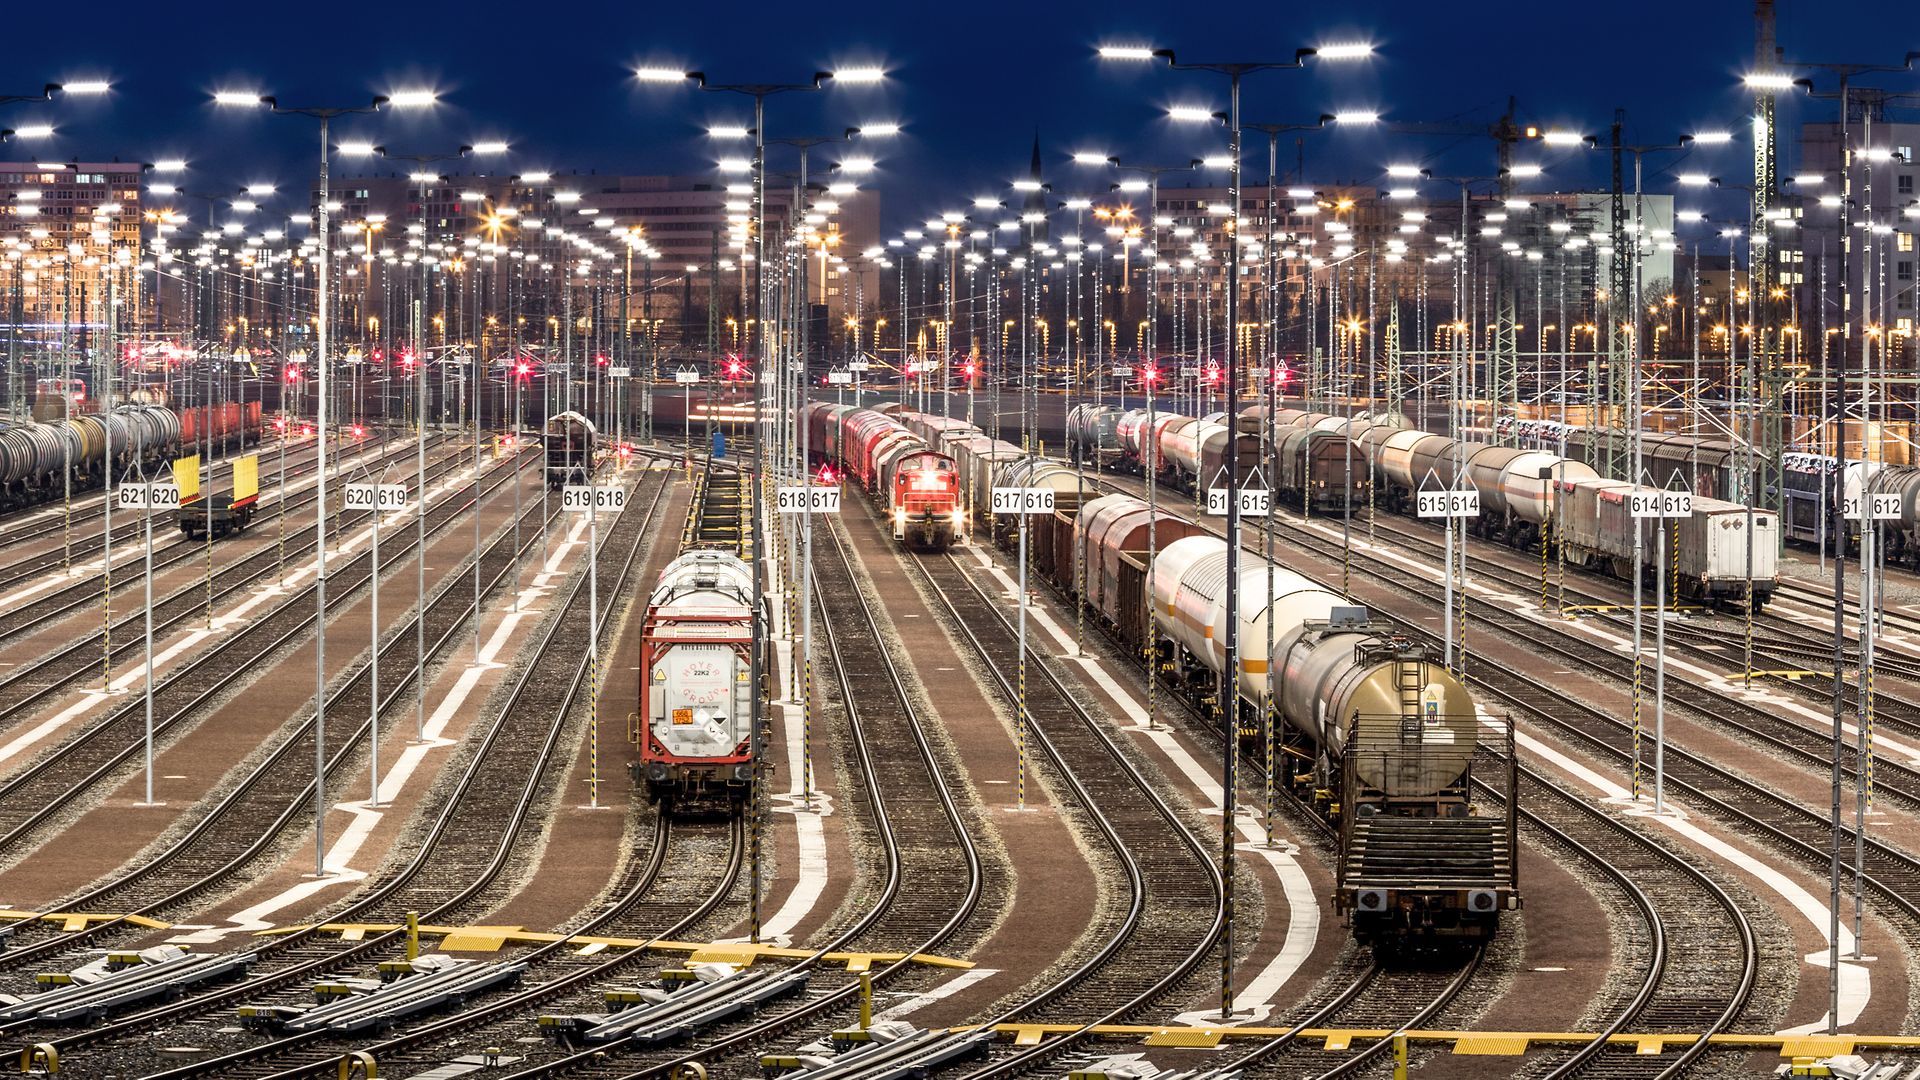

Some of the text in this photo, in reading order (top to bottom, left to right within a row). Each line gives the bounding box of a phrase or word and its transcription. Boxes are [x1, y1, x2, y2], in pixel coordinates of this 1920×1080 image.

[120, 488, 146, 504] 621
[152, 488, 179, 504] 620
[346, 488, 373, 505] 620
[378, 489, 406, 505] 619
[564, 490, 591, 507] 619
[596, 491, 623, 507] 618
[779, 492, 806, 508] 618
[811, 492, 839, 508] 617
[993, 492, 1020, 508] 617
[1025, 492, 1053, 508] 616
[1209, 493, 1229, 509] 61
[1242, 494, 1269, 511] 615
[1419, 496, 1446, 512] 615
[1451, 495, 1479, 512] 614
[1632, 496, 1659, 512] 614
[1664, 496, 1691, 512] 613
[1843, 498, 1862, 514] 61
[1874, 498, 1901, 514] 612
[682, 661, 720, 677] HOYER
